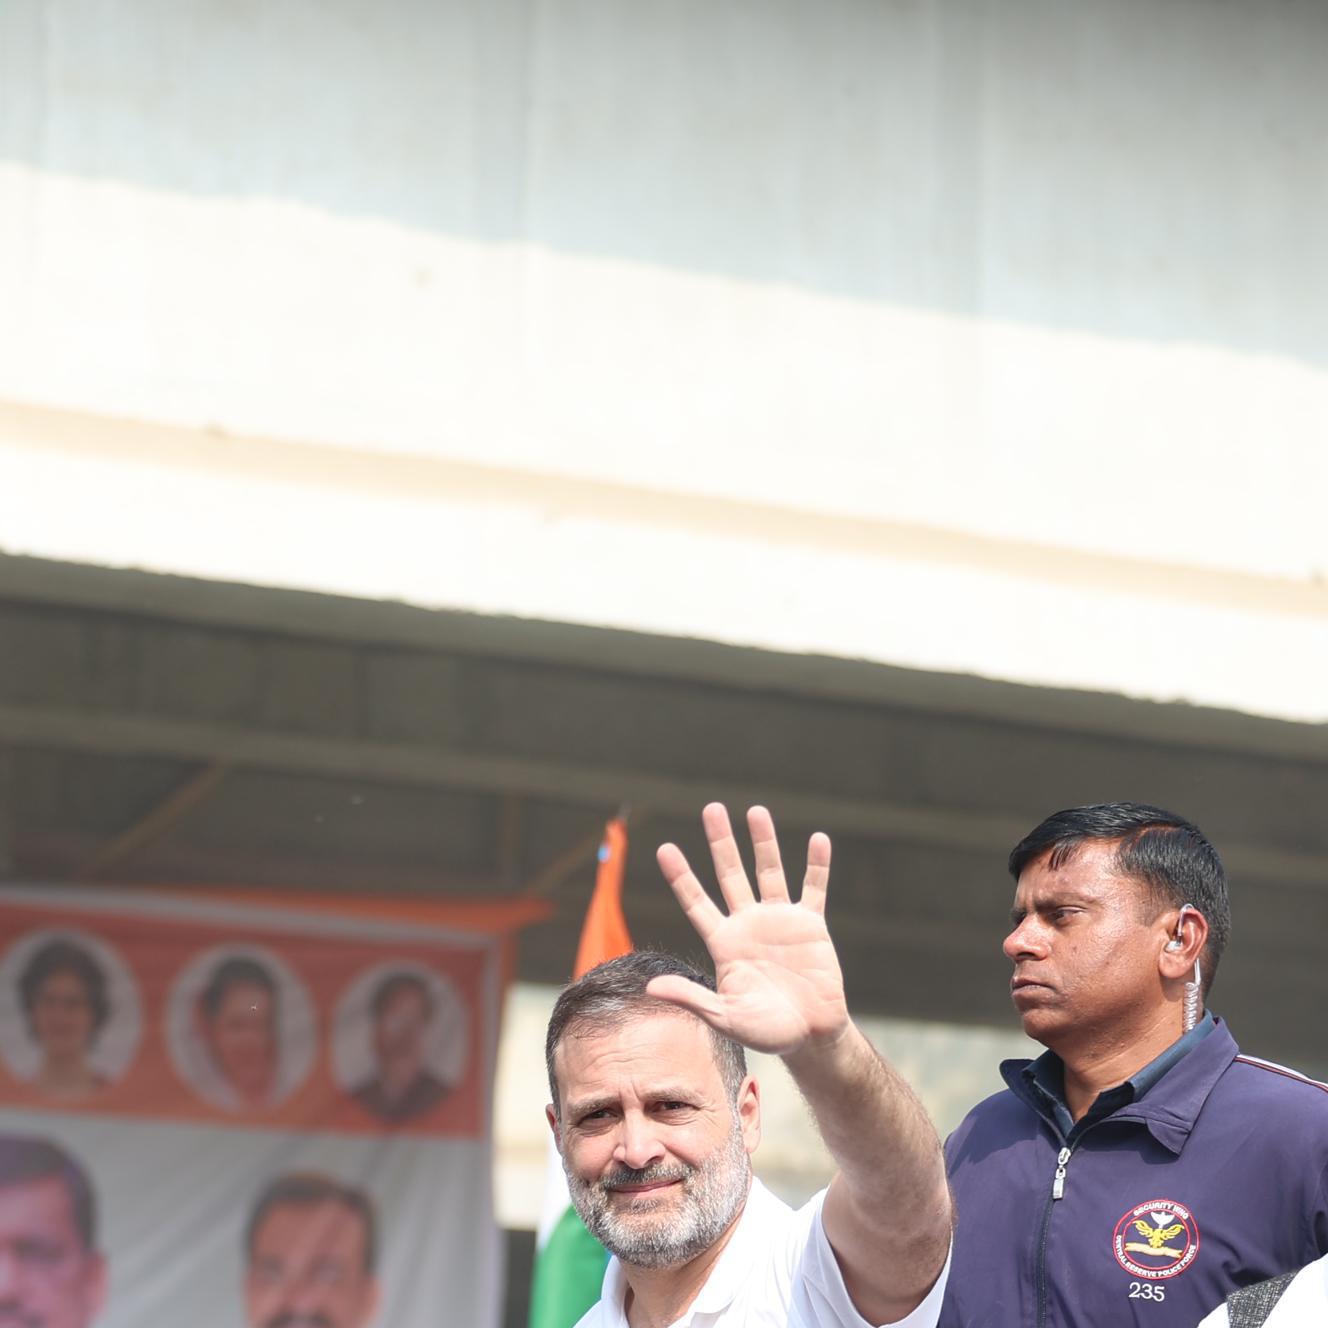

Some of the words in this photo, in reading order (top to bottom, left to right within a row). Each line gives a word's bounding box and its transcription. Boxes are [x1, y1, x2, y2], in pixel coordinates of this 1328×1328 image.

[1134, 1202, 1173, 1216] SECURITY
[1158, 1264, 1182, 1277] POLICE
[1128, 1281, 1165, 1302] 235
